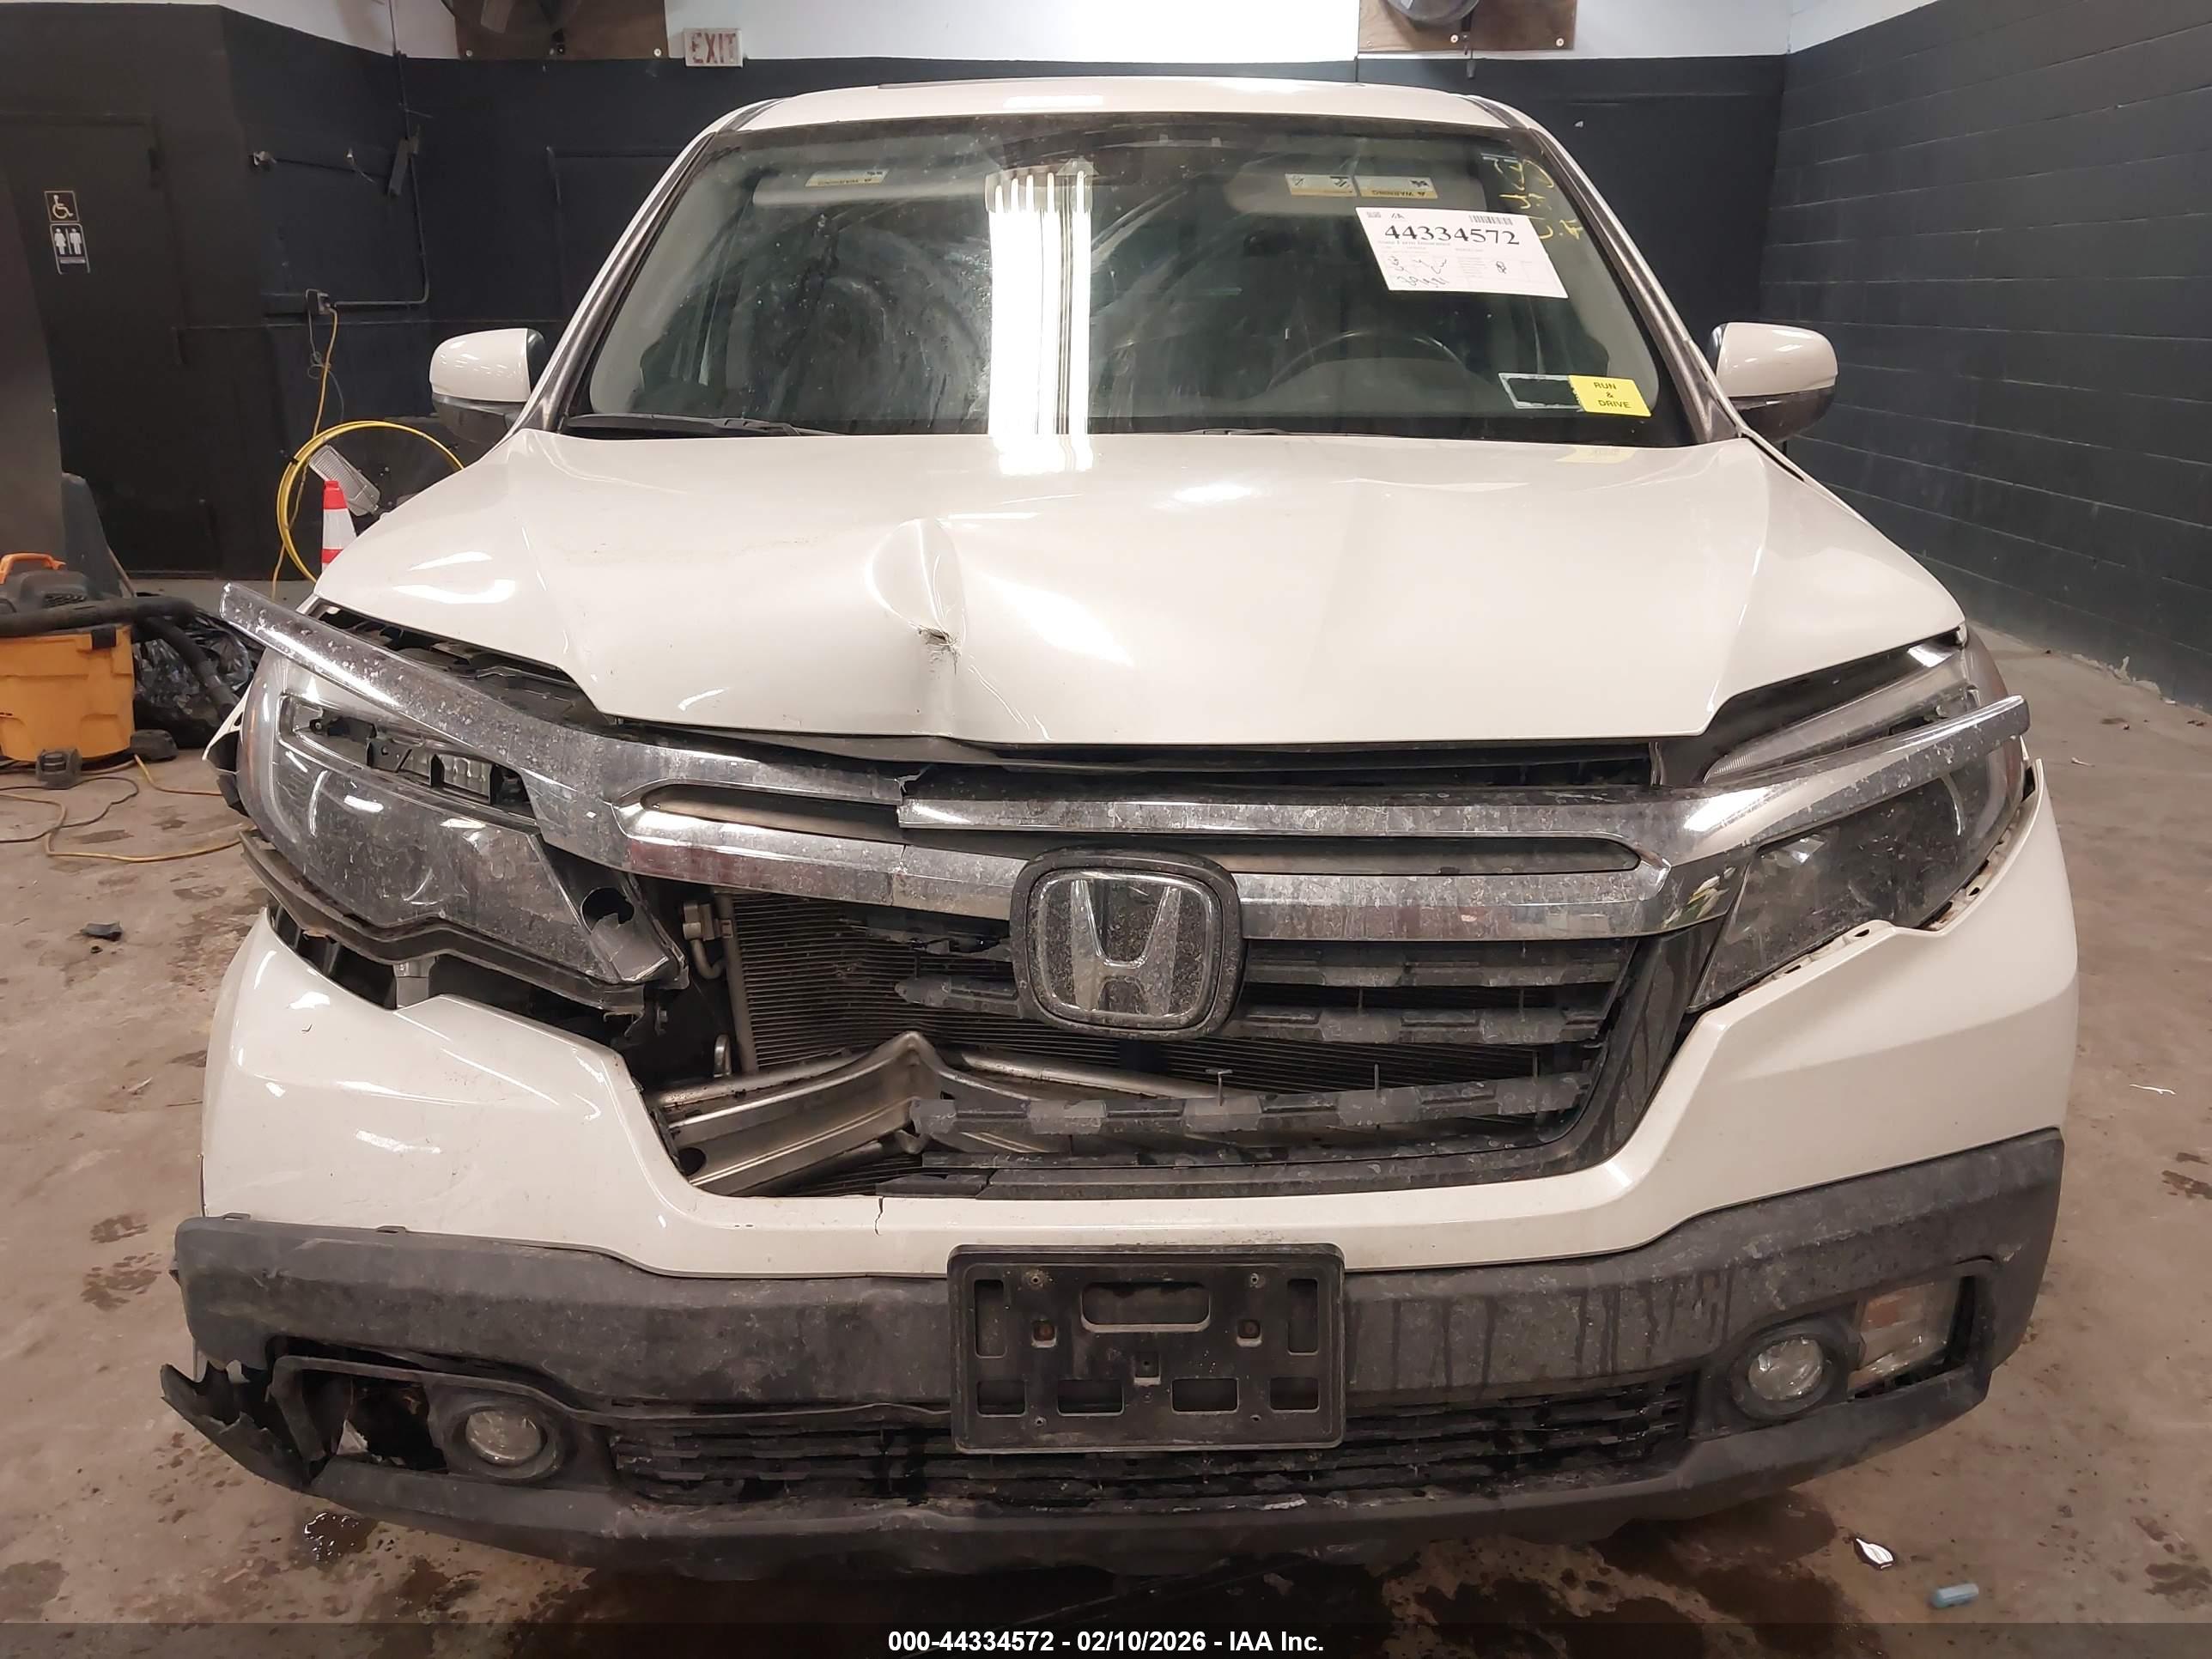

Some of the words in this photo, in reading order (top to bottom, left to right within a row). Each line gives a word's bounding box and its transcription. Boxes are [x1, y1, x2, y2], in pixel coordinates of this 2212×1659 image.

[691, 33, 737, 64] EXIT
[1384, 225, 1520, 245] 44334572
[1593, 381, 1618, 390] RUN
[1598, 399, 1632, 409] DRIVE
